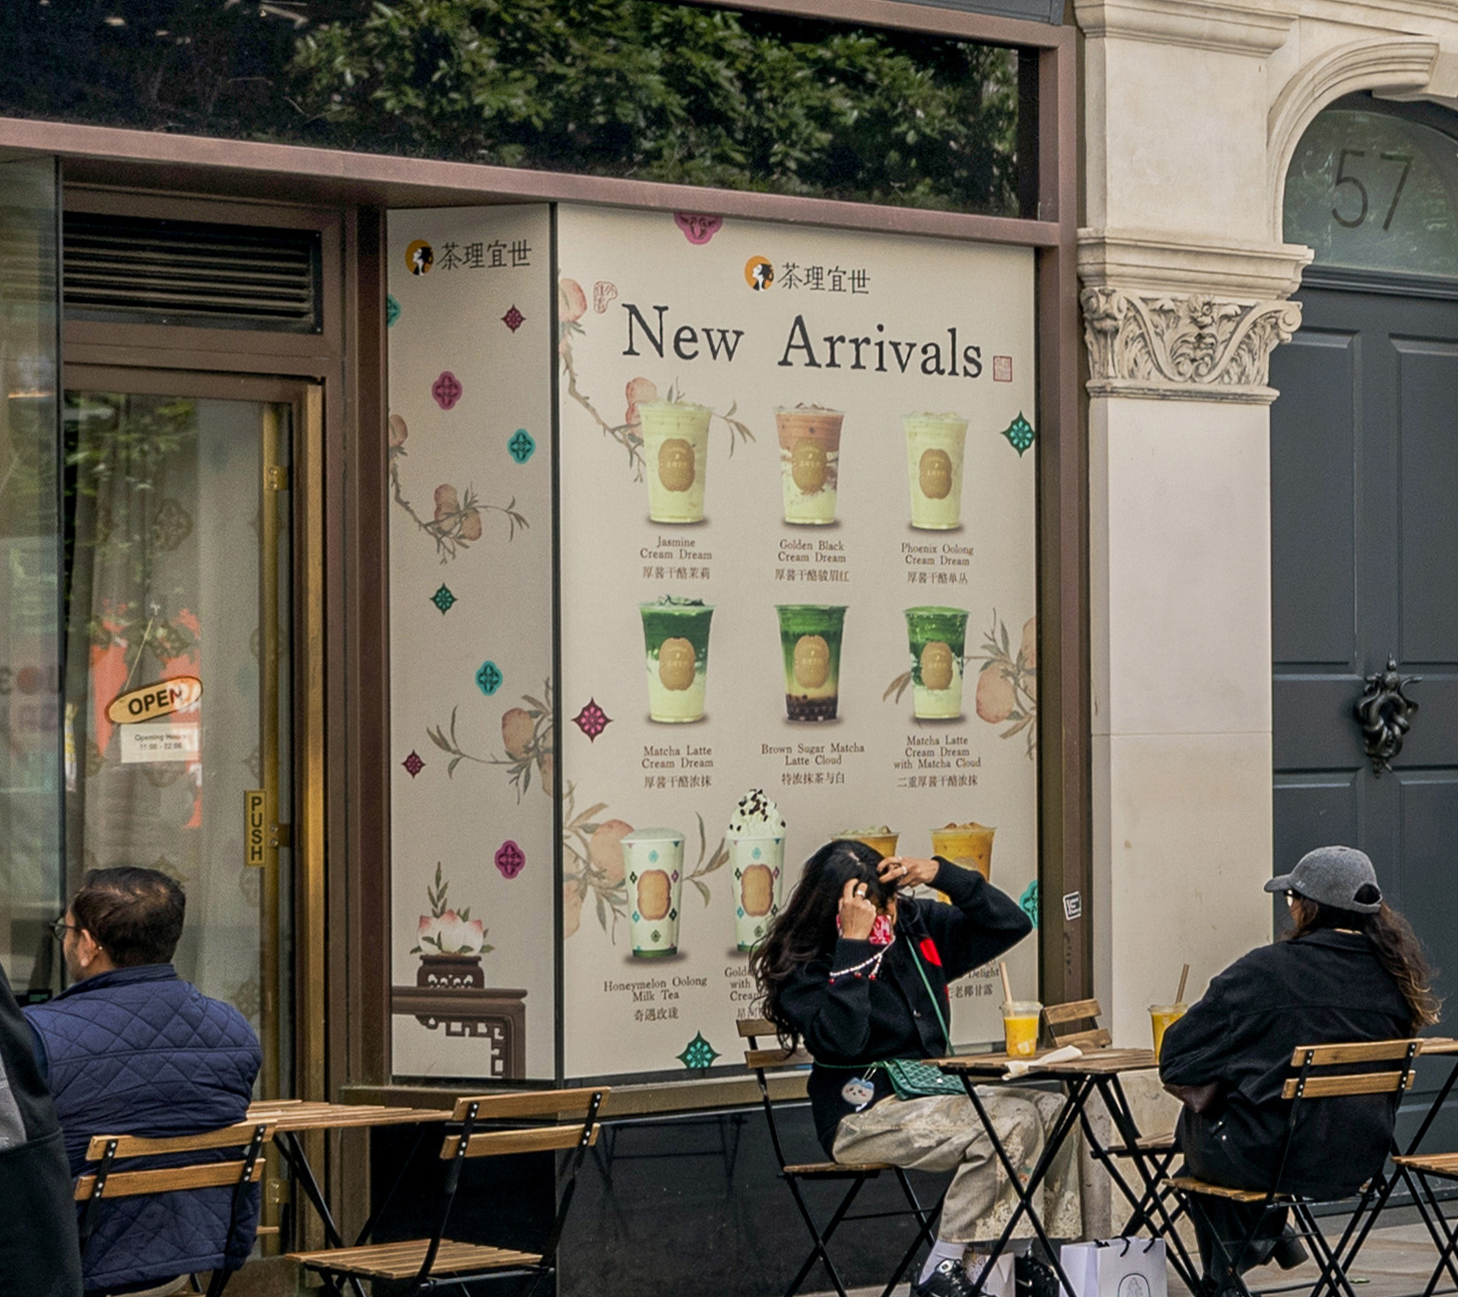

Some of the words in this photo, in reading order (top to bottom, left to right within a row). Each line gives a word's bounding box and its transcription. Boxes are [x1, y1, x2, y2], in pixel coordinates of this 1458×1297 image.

[1331, 148, 1415, 232] 57
[436, 239, 532, 271] 茶理宜世
[777, 261, 871, 296] 茶理宜世
[621, 302, 744, 363] New
[777, 313, 983, 379] Arrivals
[656, 536, 696, 548] Jasmine
[779, 539, 813, 551] Golden
[818, 540, 845, 551] Black
[640, 548, 674, 559] Cream
[679, 549, 713, 560] Dream
[901, 542, 938, 554] Phoenix
[942, 543, 974, 556] Oolong
[777, 551, 810, 562] Cream
[815, 552, 847, 563] Dream
[905, 554, 936, 565] Cream
[940, 555, 970, 566] Dream
[128, 688, 182, 716] OPEN
[134, 734, 164, 742] Opening
[907, 735, 940, 746] Matcha
[945, 735, 968, 745] Latte
[643, 745, 681, 756] Matcha
[686, 745, 712, 756] Latte
[761, 743, 793, 755] Brown
[797, 743, 825, 755] Sugar
[830, 742, 865, 753] Matcha
[905, 747, 935, 757] Cream
[940, 747, 970, 757] Dream
[641, 757, 675, 769] Cream
[680, 757, 714, 768] Dream
[785, 755, 810, 766] Latte
[814, 754, 842, 765] Cloud
[893, 759, 913, 769] with
[918, 758, 951, 769] Matcha
[955, 757, 981, 768] Cloud
[250, 795, 263, 862] PUSH
[603, 978, 667, 992] Honeymelon
[672, 975, 708, 988] Oolong
[730, 977, 751, 989] with
[632, 992, 655, 1003] Milk
[661, 989, 680, 1001] Tea
